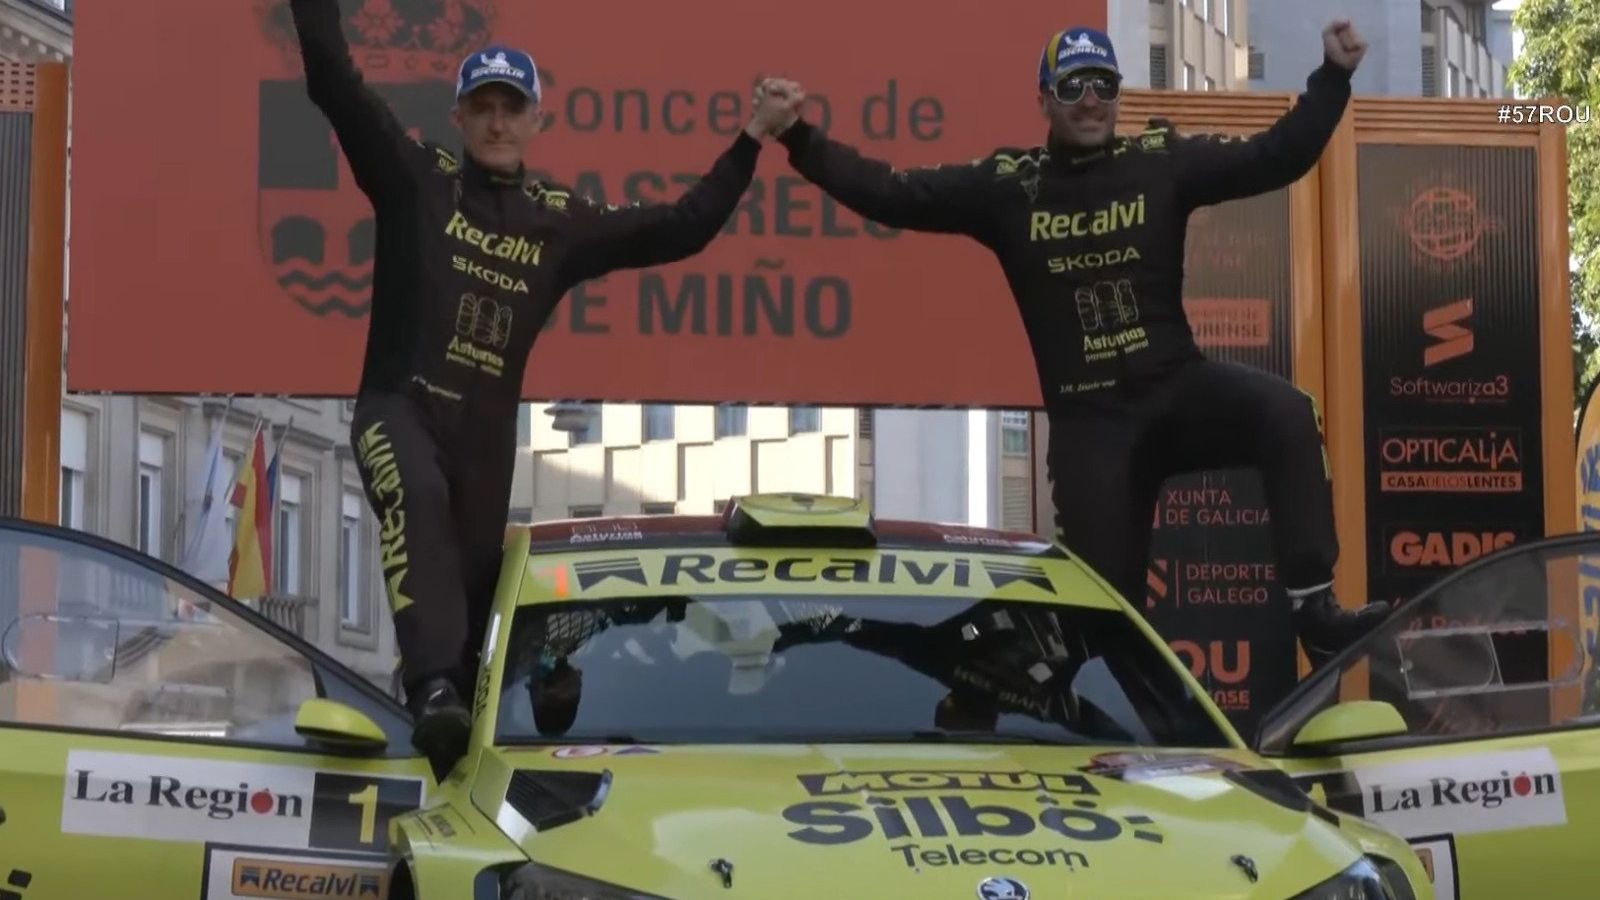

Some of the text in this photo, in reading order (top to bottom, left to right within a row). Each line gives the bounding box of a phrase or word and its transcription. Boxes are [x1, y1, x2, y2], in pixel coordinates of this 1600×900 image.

[539, 67, 944, 141] onceo de
[1030, 192, 1146, 241] Recalvi
[445, 210, 545, 267] Recalvi
[637, 258, 853, 340] MIÑO
[1083, 326, 1146, 351] Asturias
[1390, 376, 1509, 397] Softwariza3
[1167, 488, 1232, 506] XUNTA
[1165, 508, 1271, 526] DE GALICIA
[660, 553, 971, 588] Recalvi
[1186, 563, 1276, 582] DEPORTE
[1187, 587, 1268, 606] GALEGO
[71, 769, 303, 820] La Región
[820, 771, 1084, 793] MOTUL
[1369, 770, 1556, 813] La Región
[348, 784, 379, 844] 1
[891, 844, 1090, 868] Telecom
[261, 869, 357, 897] Recalvi
